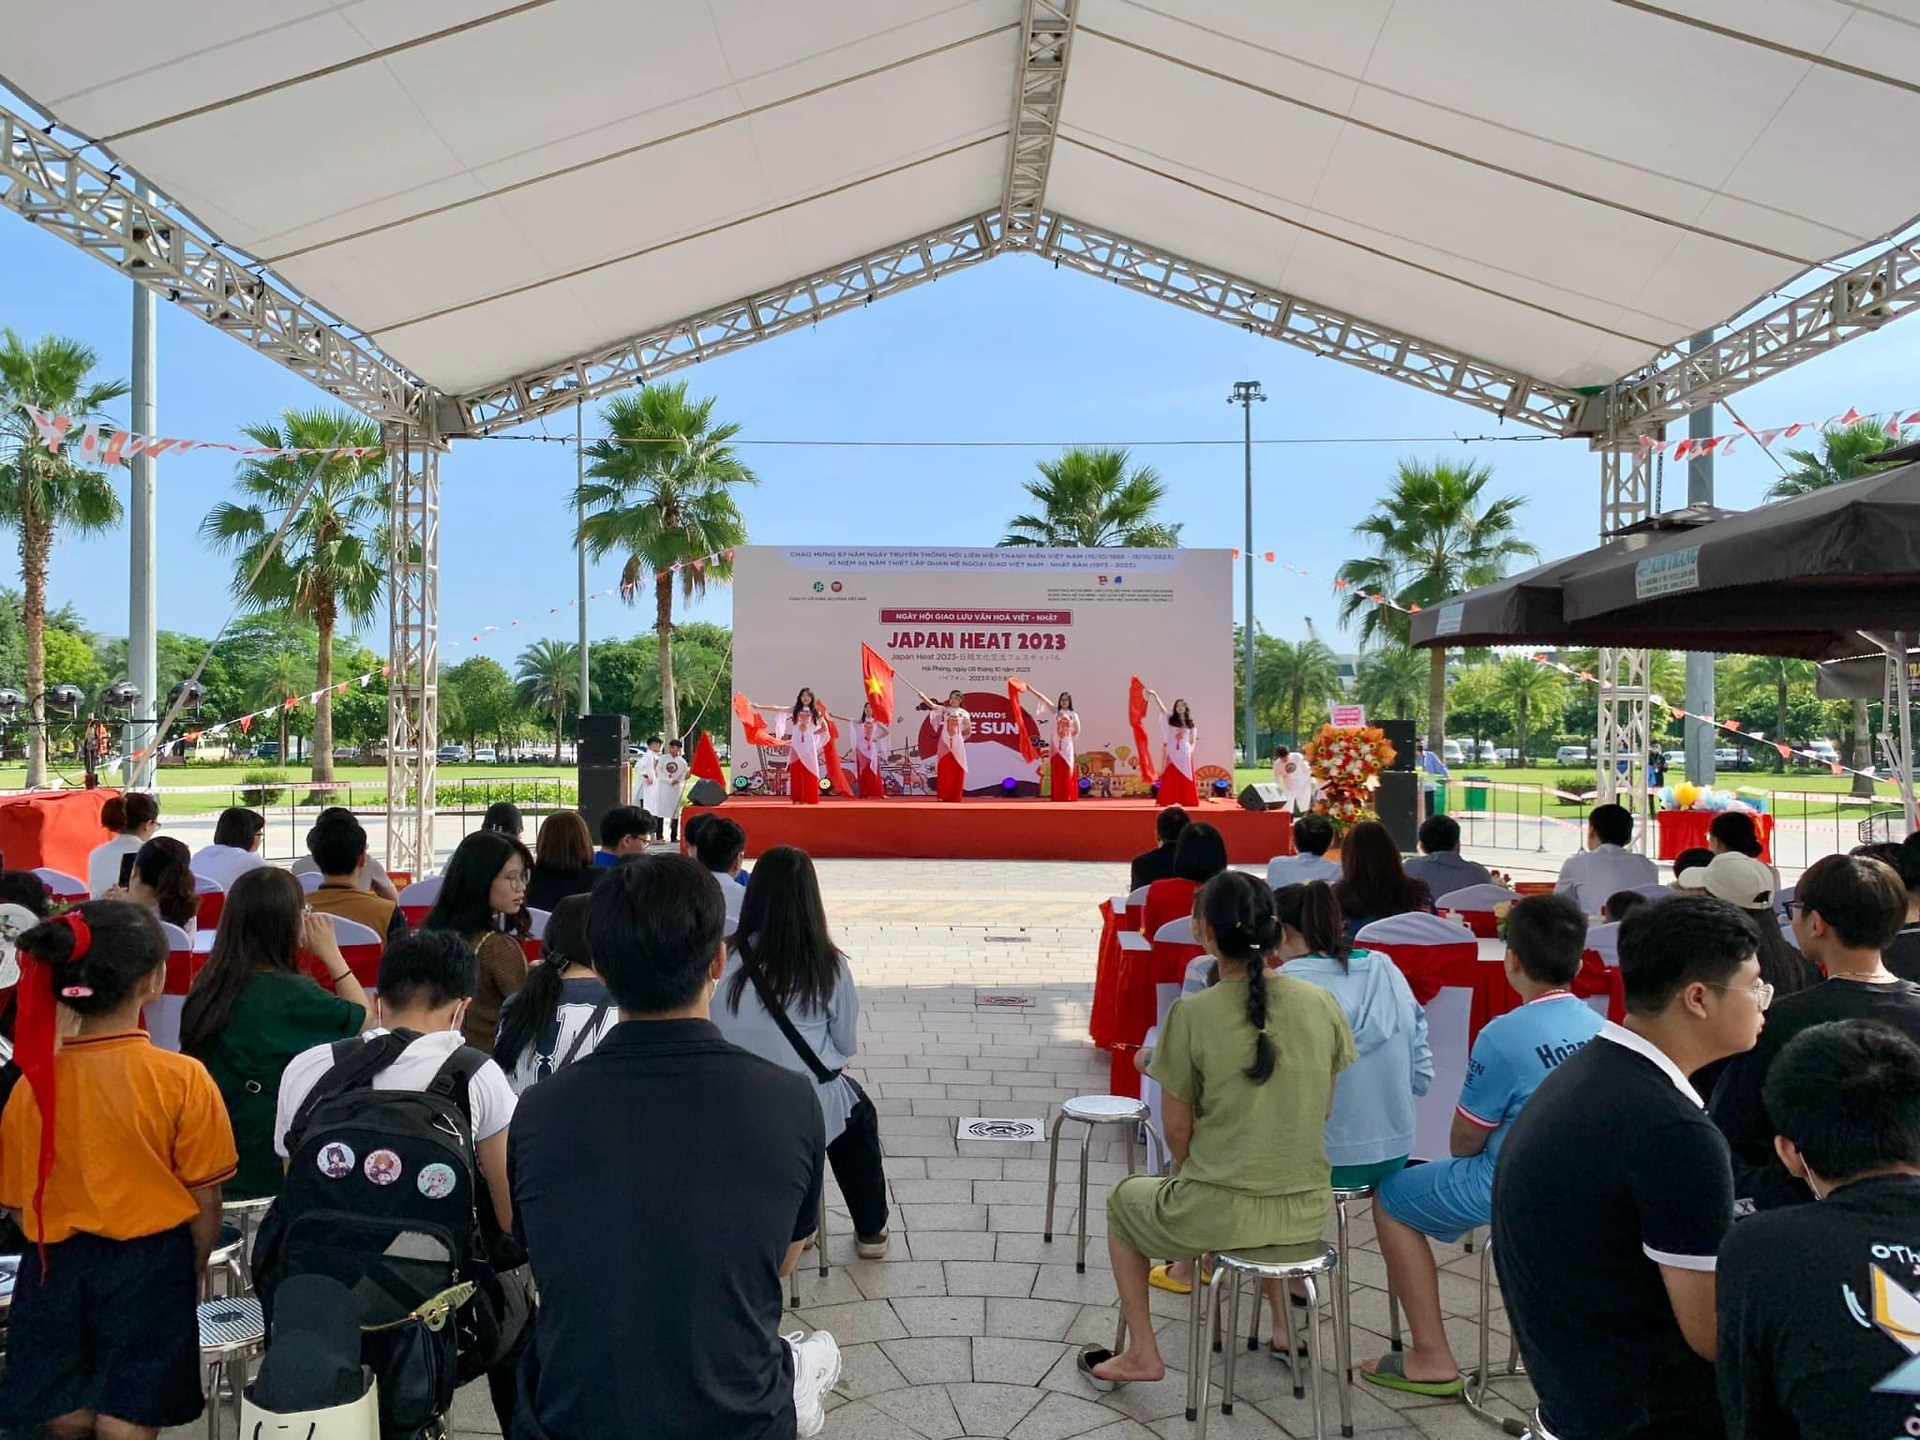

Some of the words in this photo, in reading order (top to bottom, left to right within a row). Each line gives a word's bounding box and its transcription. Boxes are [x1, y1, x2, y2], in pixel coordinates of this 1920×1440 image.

[895, 612, 918, 620] NGÀY
[919, 613, 934, 621] HỘI
[956, 612, 973, 620] LƯU
[975, 613, 991, 621] VĂN
[1012, 613, 1030, 622] VIỆT
[1037, 614, 1058, 622] NHẬT
[887, 631, 954, 649] JAPAN
[959, 632, 1012, 650] HEAT
[1017, 632, 1066, 650] 2023
[891, 653, 915, 661] Japan
[981, 722, 1019, 735] SUN
[1535, 1038, 1592, 1069] Hoàn
